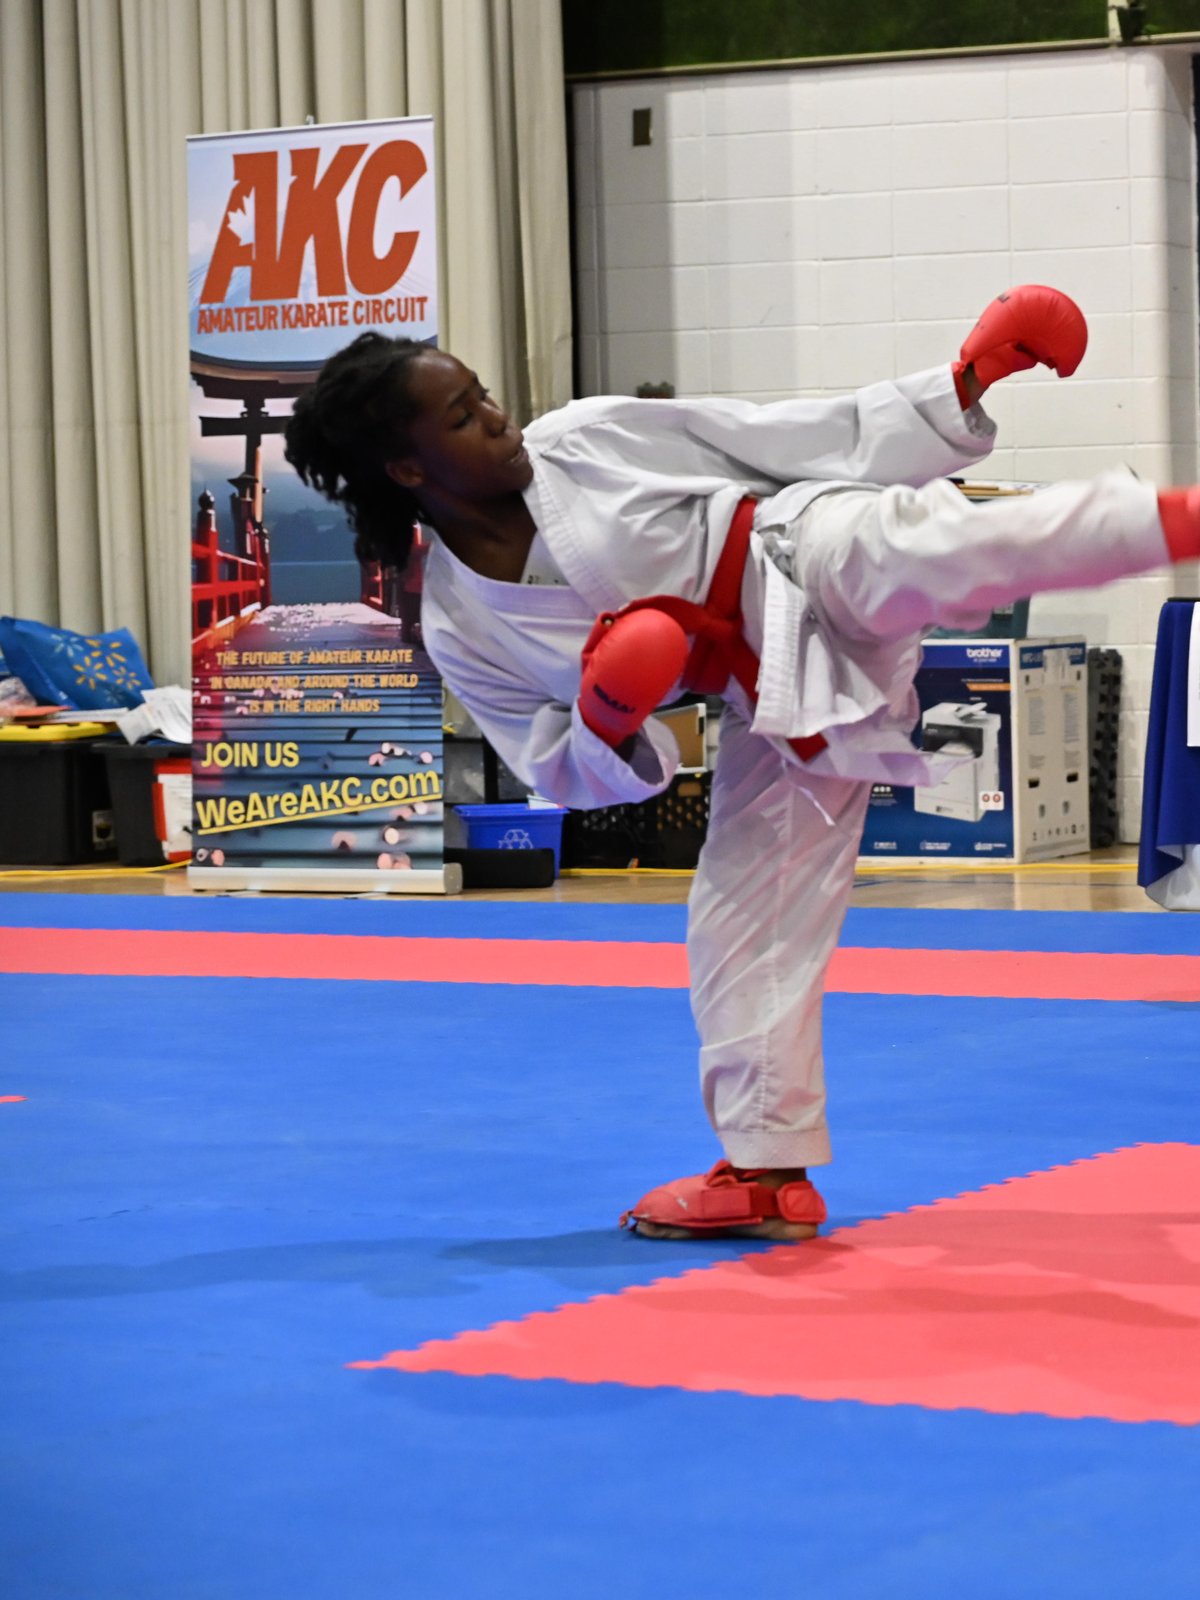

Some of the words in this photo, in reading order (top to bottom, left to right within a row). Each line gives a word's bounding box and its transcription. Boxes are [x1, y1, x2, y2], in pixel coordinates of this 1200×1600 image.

[200, 139, 428, 305] AKC
[197, 306, 279, 334] AMATEUR
[281, 301, 348, 330] KARATE
[353, 296, 428, 325] CIRCUIT
[216, 652, 238, 665] THE
[242, 651, 284, 665] FUTURE
[289, 651, 304, 664] OF
[308, 650, 362, 664] AMATEUR
[366, 649, 413, 663] KARATE
[209, 677, 222, 689] IN
[224, 676, 273, 689] CANADA
[274, 675, 299, 689] AND
[304, 675, 349, 688] AROUND
[353, 674, 377, 687] THE
[379, 674, 419, 688] WORLD
[250, 700, 259, 712] IS
[263, 700, 274, 712] IN
[279, 699, 299, 712] THE
[304, 699, 336, 712] RIGHT
[341, 699, 380, 712] HANDS
[201, 742, 258, 767] JOIN
[265, 742, 299, 767] US
[196, 770, 440, 830] WeAreAKC.com
